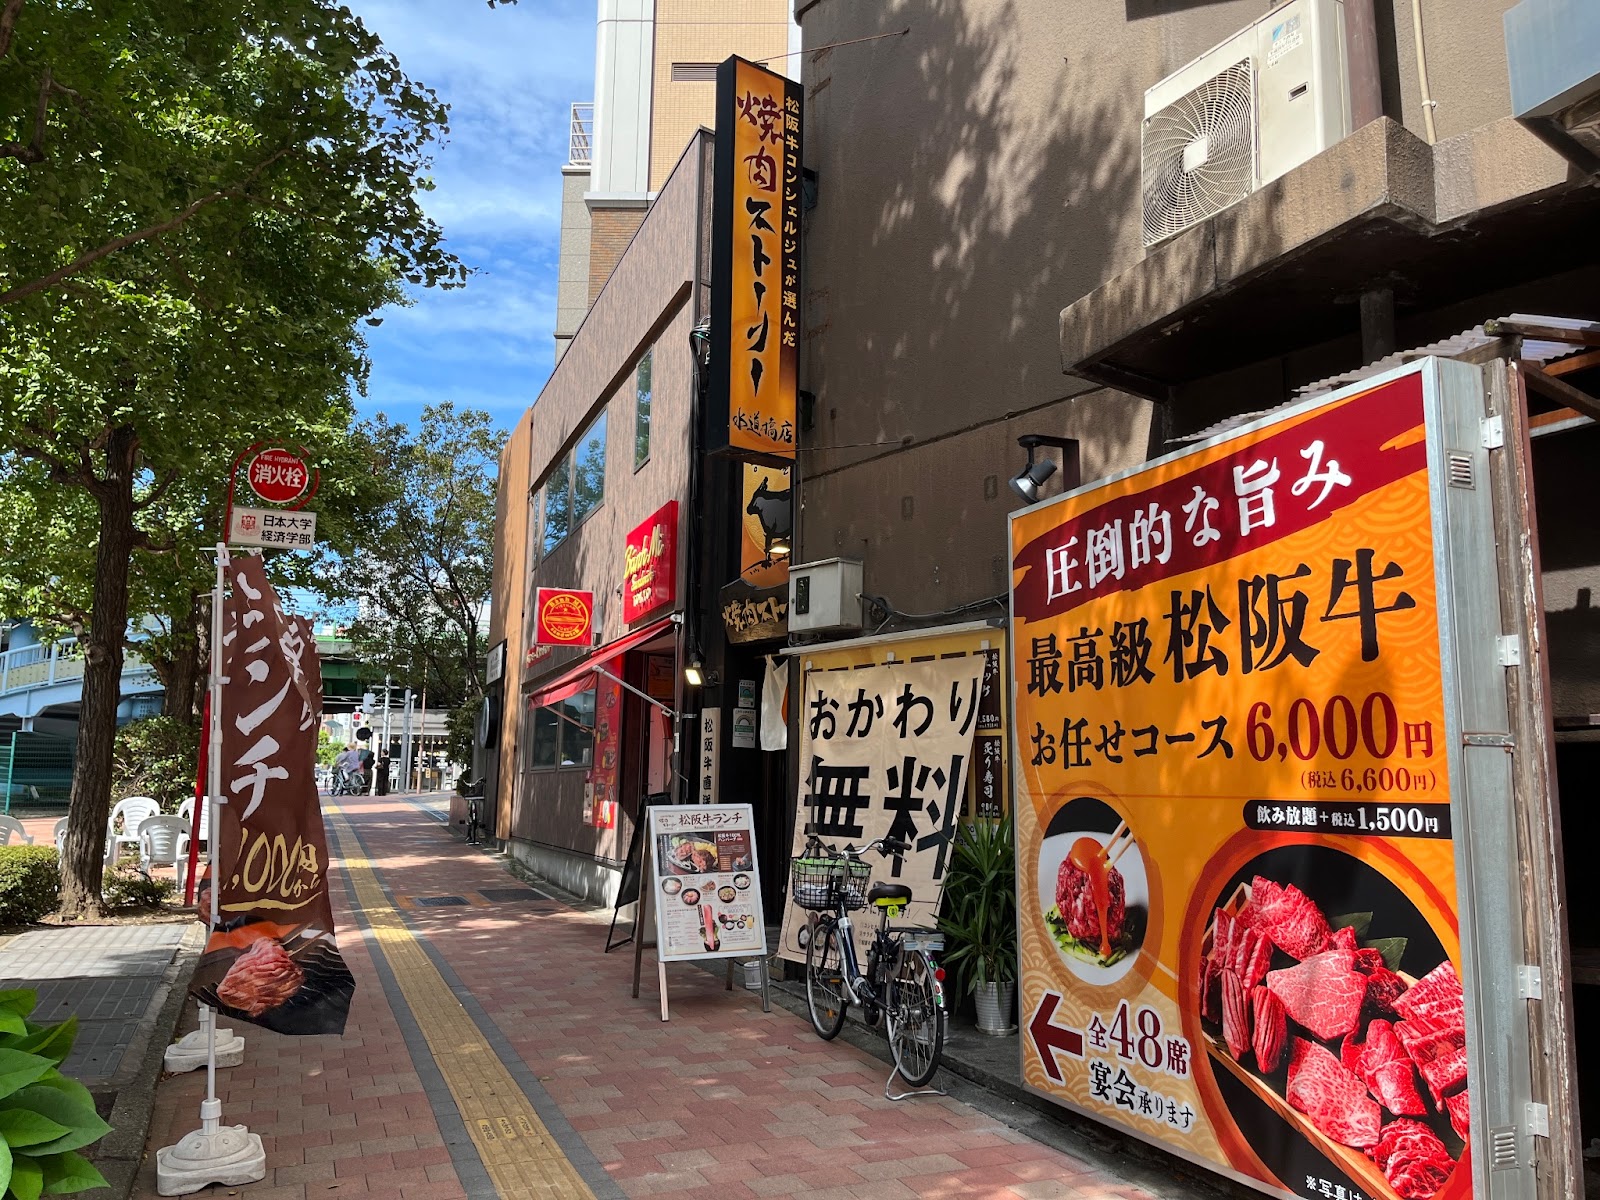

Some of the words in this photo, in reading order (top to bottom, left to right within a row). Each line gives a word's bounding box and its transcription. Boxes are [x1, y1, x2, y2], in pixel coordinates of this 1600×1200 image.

[736, 90, 786, 398] 焼肉ストーリー
[782, 95, 801, 348] 松阪牛コンシェルジュが選んだ
[732, 407, 793, 444] 水道橋店
[253, 463, 304, 488] 消火栓
[260, 454, 273, 462] FIRE
[274, 456, 300, 464] HYDRANT
[261, 530, 311, 545] 経済学部
[263, 514, 312, 530] 日本大学
[1045, 440, 1352, 606] 圧倒的な旨み
[1026, 548, 1417, 697] 最高級松阪牛
[810, 677, 979, 741] おかわり
[1030, 715, 1234, 770] お任せコース
[1245, 691, 1434, 763] 6,000円
[982, 741, 994, 799] 炙り寿司
[1301, 767, 1437, 794] (税込6,600円)
[679, 812, 743, 826] 松阪牛ランチ
[804, 754, 965, 880] 無料
[1088, 1001, 1191, 1076] 全48席
[1089, 1062, 1195, 1129] 宴会承ります
